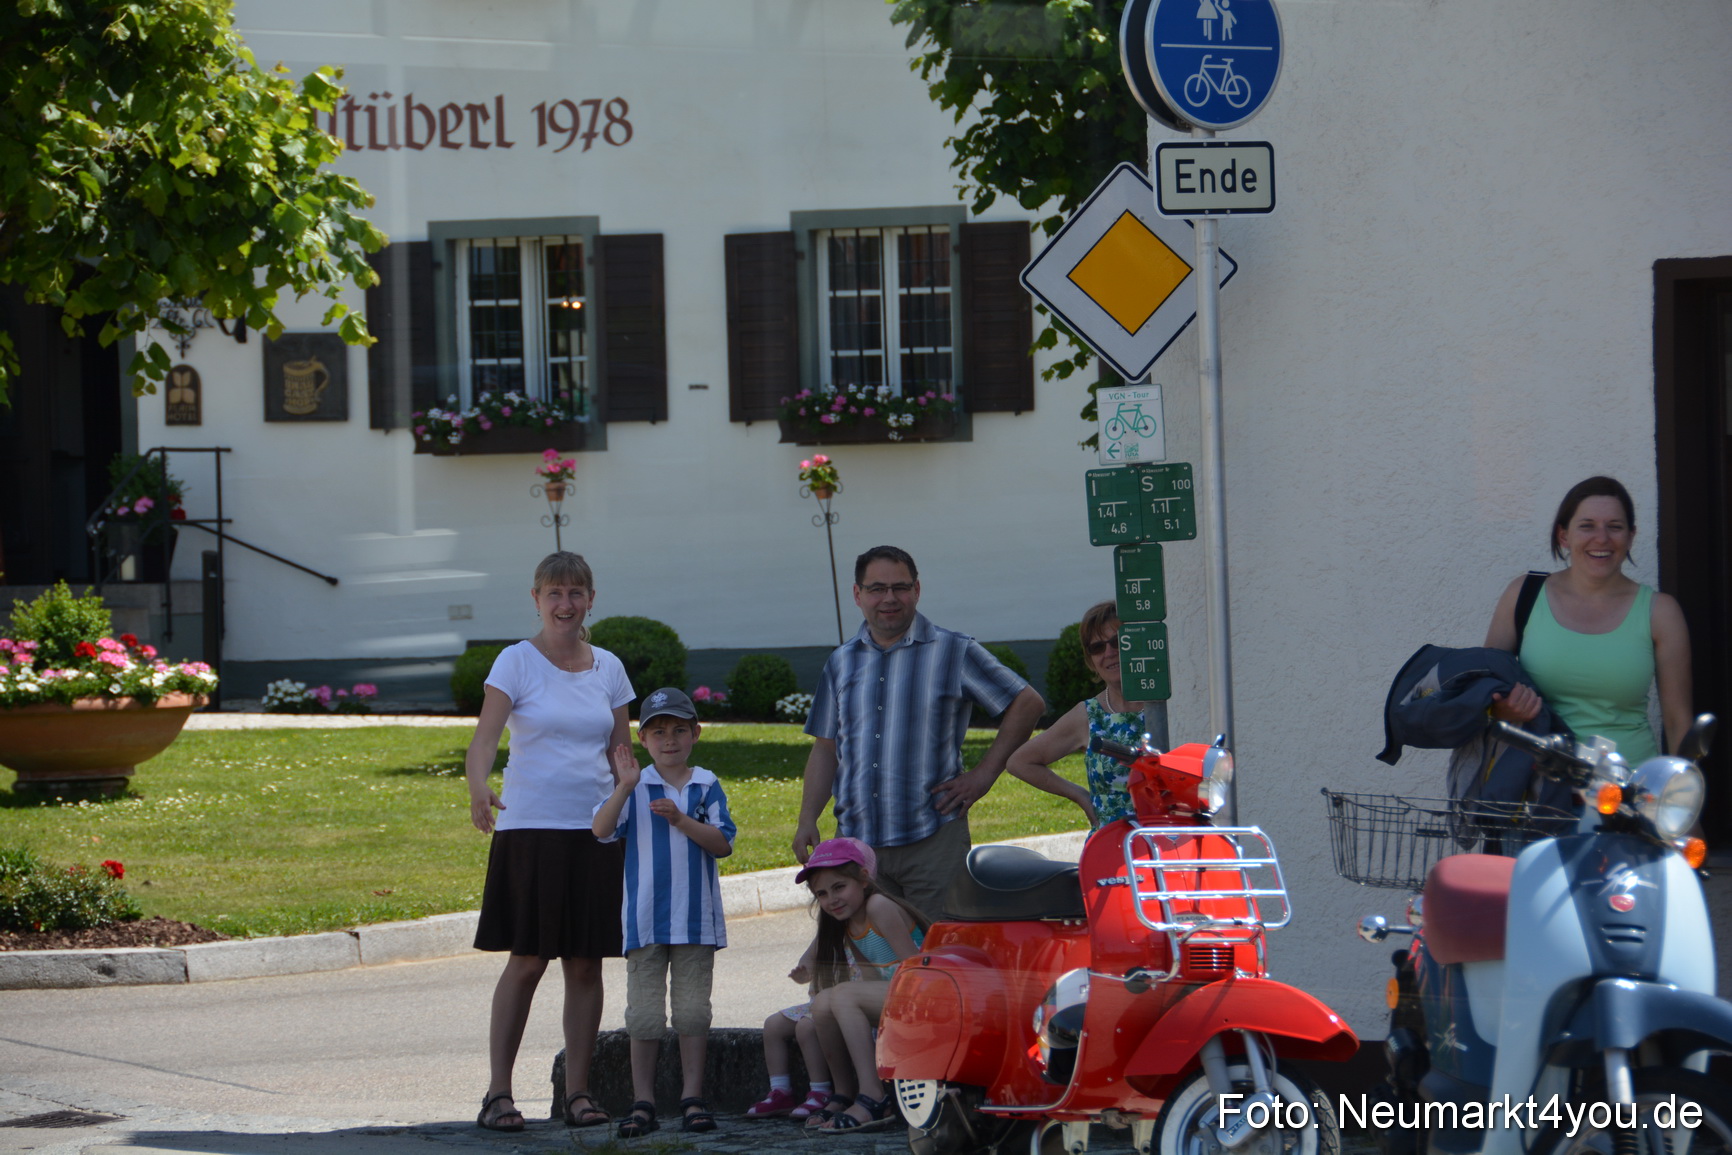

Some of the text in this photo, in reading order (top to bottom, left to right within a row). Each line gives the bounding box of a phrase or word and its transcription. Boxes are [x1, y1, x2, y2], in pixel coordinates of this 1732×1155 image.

[313, 90, 633, 153] stüberl 1978
[1175, 158, 1257, 193] Ende
[1132, 391, 1150, 399] Tour
[1141, 475, 1191, 492] S 100
[1120, 634, 1164, 651] S 100
